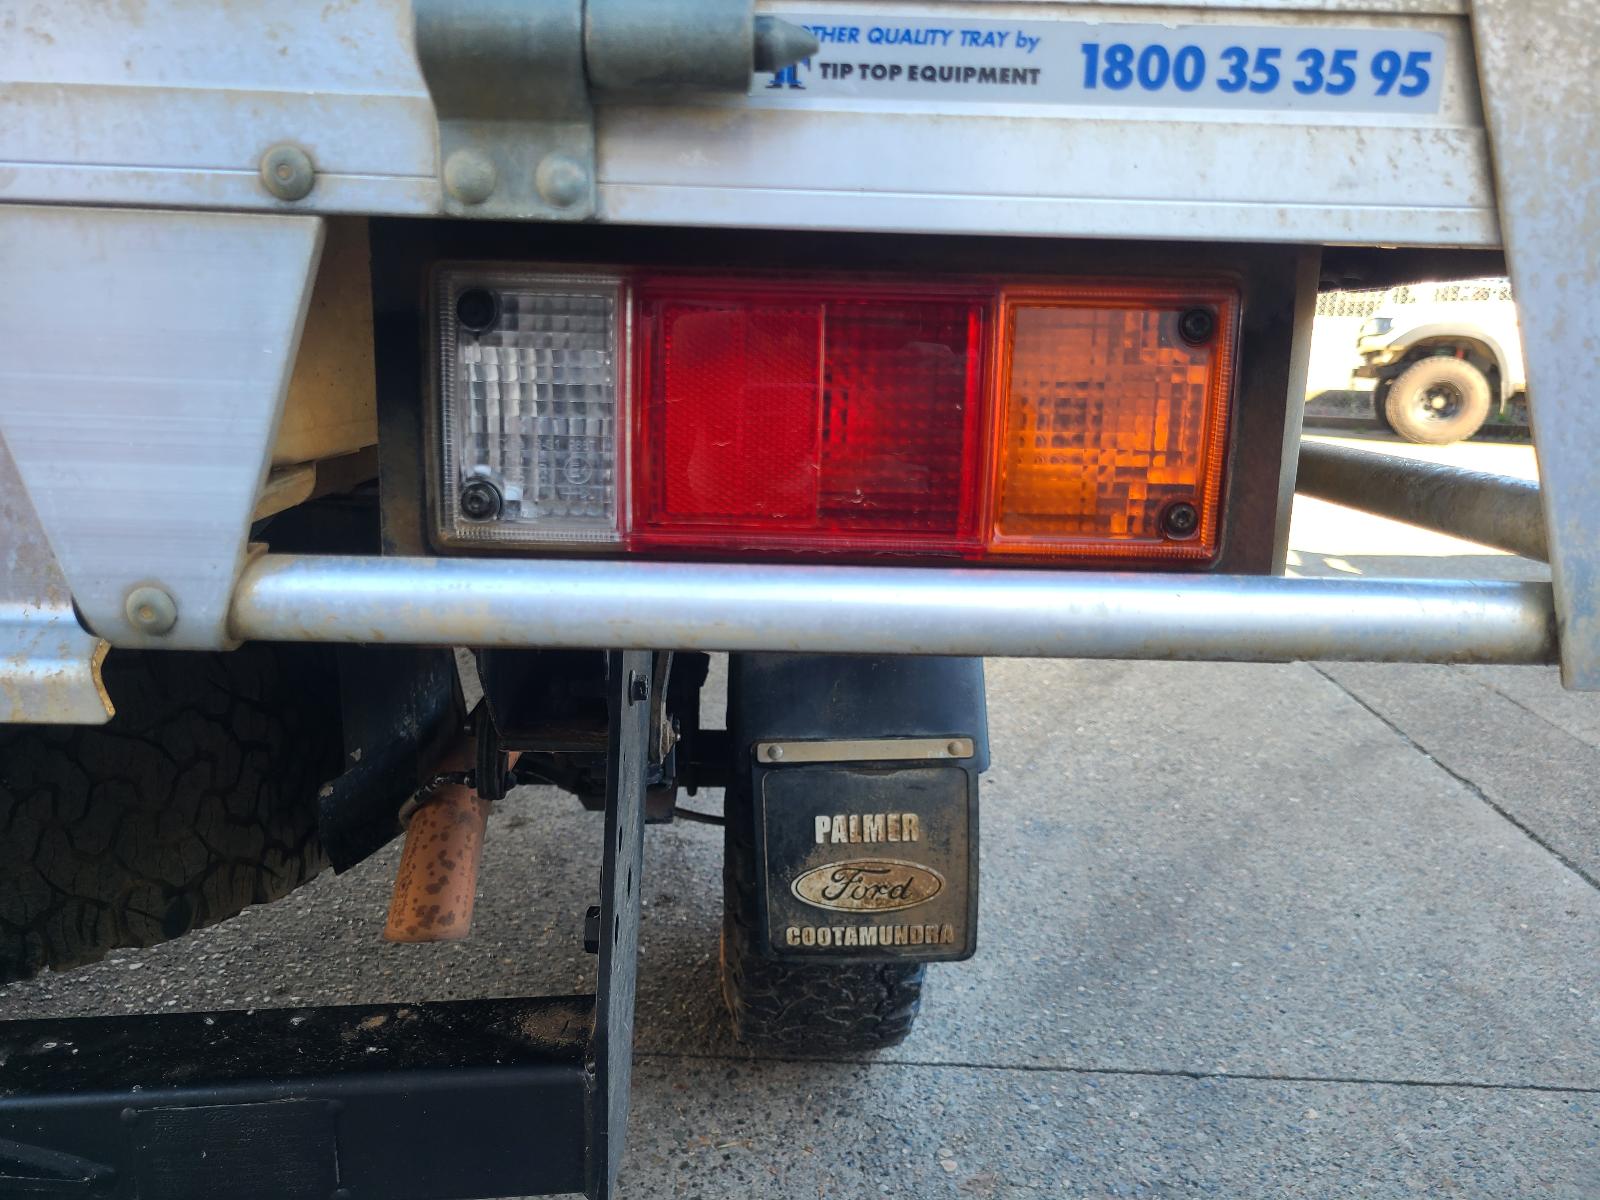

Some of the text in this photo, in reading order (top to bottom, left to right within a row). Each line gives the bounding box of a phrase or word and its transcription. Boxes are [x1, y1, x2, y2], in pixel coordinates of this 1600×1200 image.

[802, 25, 1040, 53] THER QUALITY TRAY by
[819, 63, 1041, 86] TIP TOP EQUIPMENT
[1081, 42, 1432, 98] 1800 35 35 95
[814, 812, 920, 844] PALMER
[821, 867, 914, 901] Ford
[785, 923, 955, 947] COOTAMUNDRA
